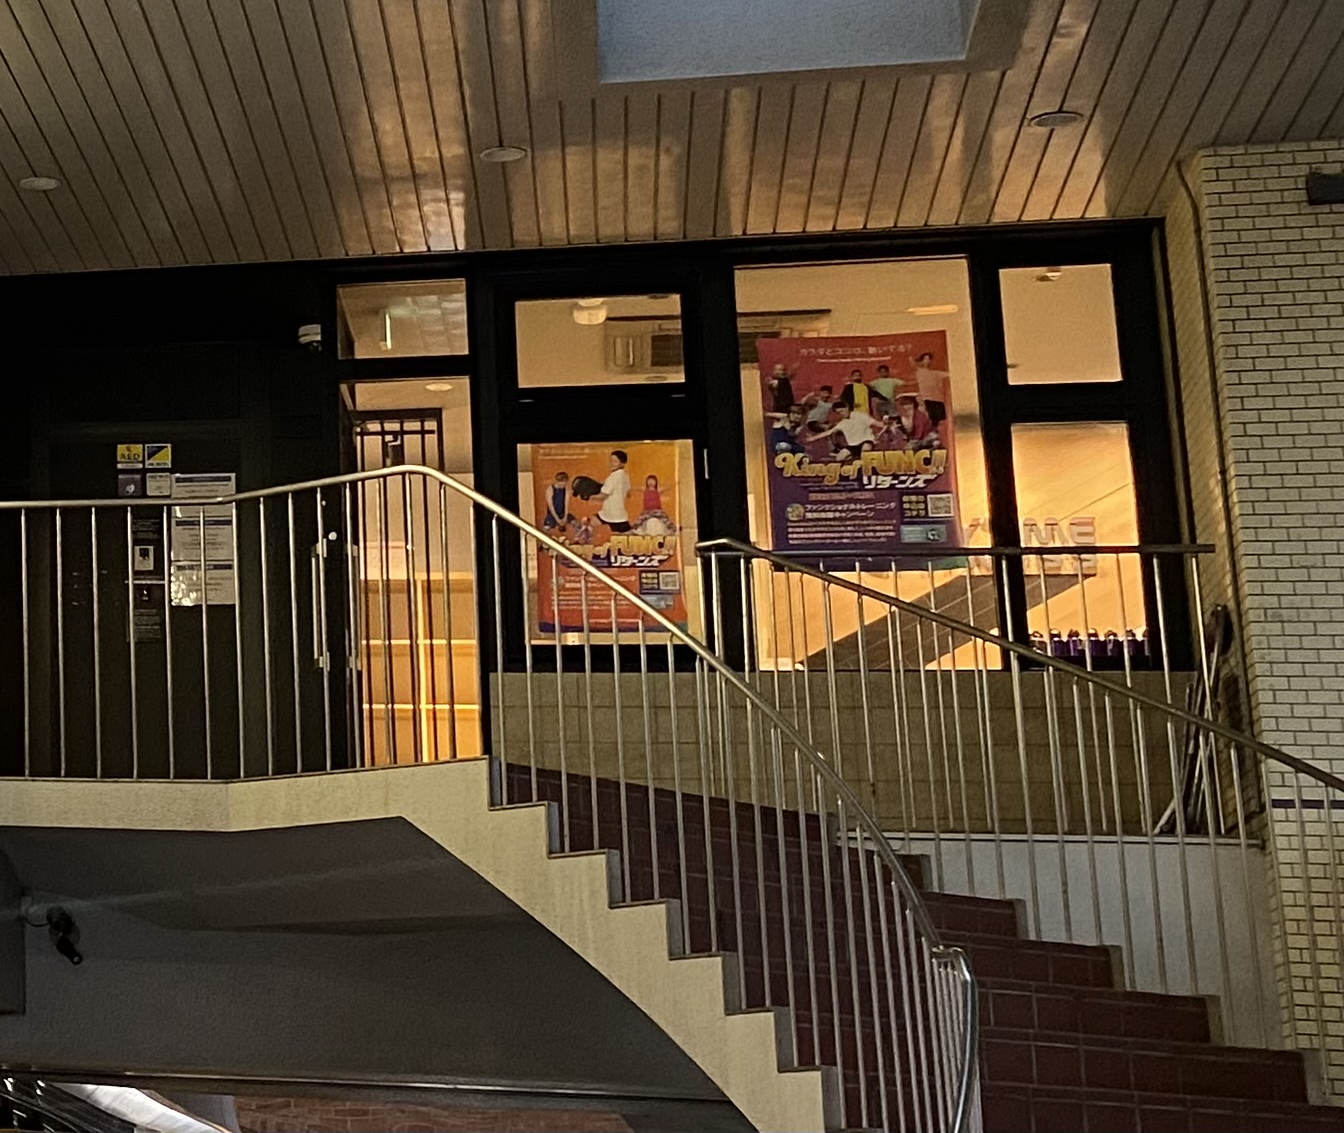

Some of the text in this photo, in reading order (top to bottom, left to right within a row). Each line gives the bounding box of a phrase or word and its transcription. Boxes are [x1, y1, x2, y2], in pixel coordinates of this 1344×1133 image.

[775, 452, 841, 485] King
[840, 460, 862, 479] of
[862, 474, 938, 489] リターンズ
[611, 555, 669, 567] リターンズ
